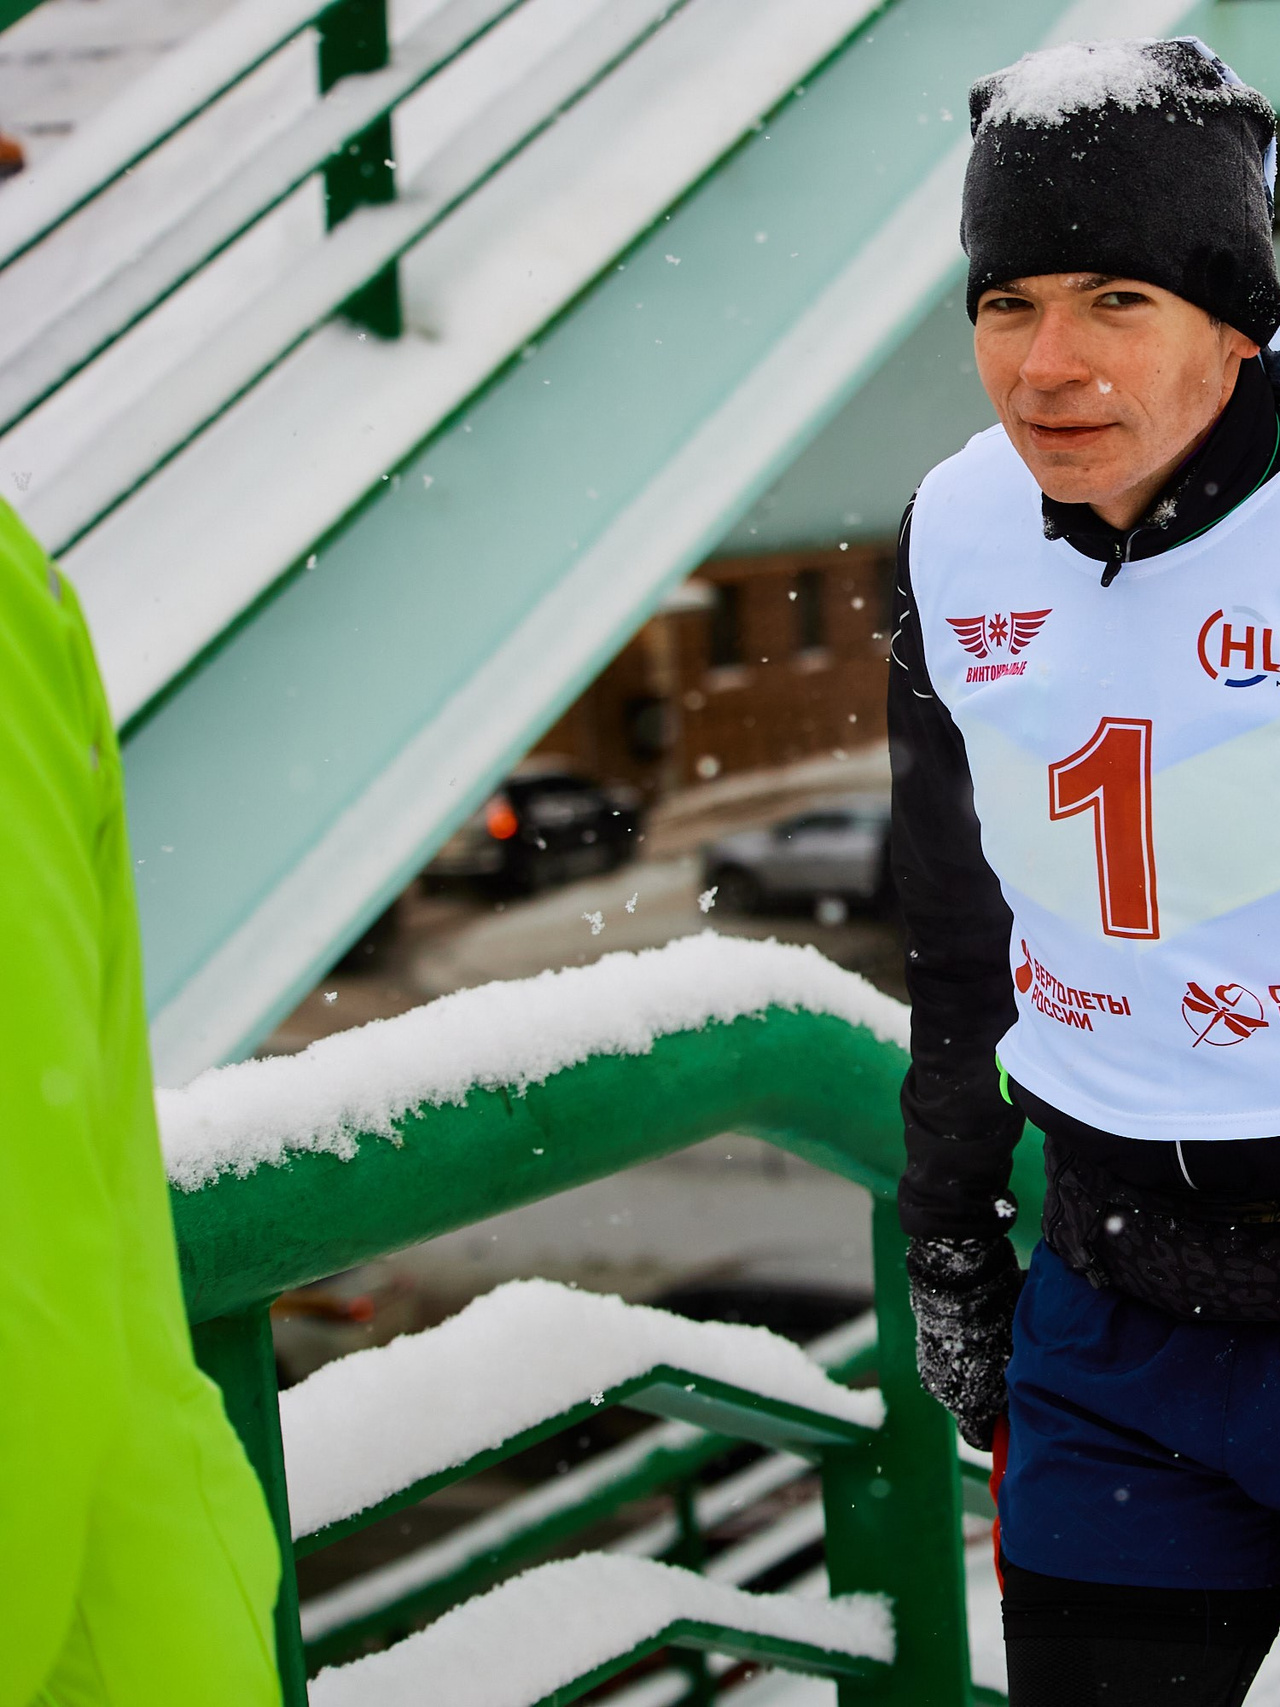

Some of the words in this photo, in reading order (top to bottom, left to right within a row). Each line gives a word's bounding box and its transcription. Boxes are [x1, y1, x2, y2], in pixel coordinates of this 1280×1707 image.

[1048, 717, 1159, 939] 1
[1031, 984, 1093, 1032] РОССИИ
[1033, 958, 1131, 1016] ВЕРТОЛЕТЫ
